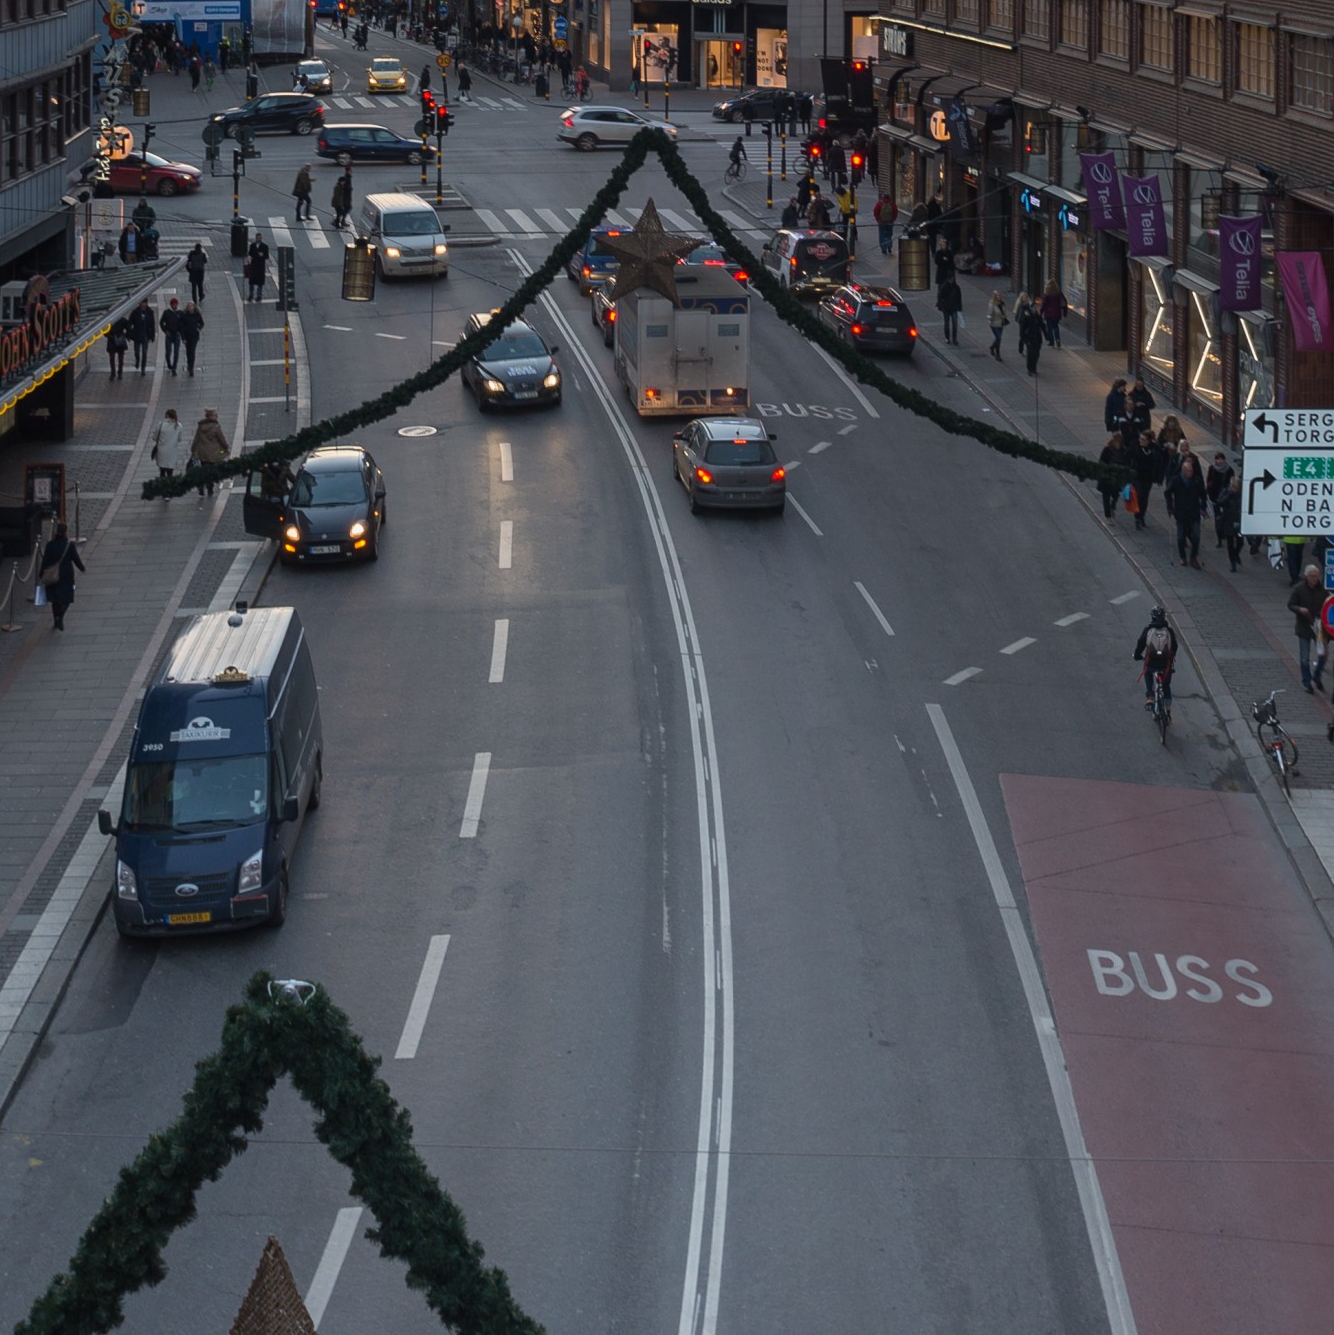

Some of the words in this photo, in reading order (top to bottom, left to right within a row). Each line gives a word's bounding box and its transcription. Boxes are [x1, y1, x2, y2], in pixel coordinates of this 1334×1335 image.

[1097, 186, 1112, 220] Telia
[1140, 209, 1154, 246] Telia
[1235, 261, 1251, 300] Telia
[755, 403, 858, 421] BUSS
[1284, 430, 1334, 443] TORG
[1293, 461, 1317, 475] E4
[1281, 499, 1293, 512] N
[142, 743, 164, 752] 3950
[1086, 949, 1273, 1007] BUSS
